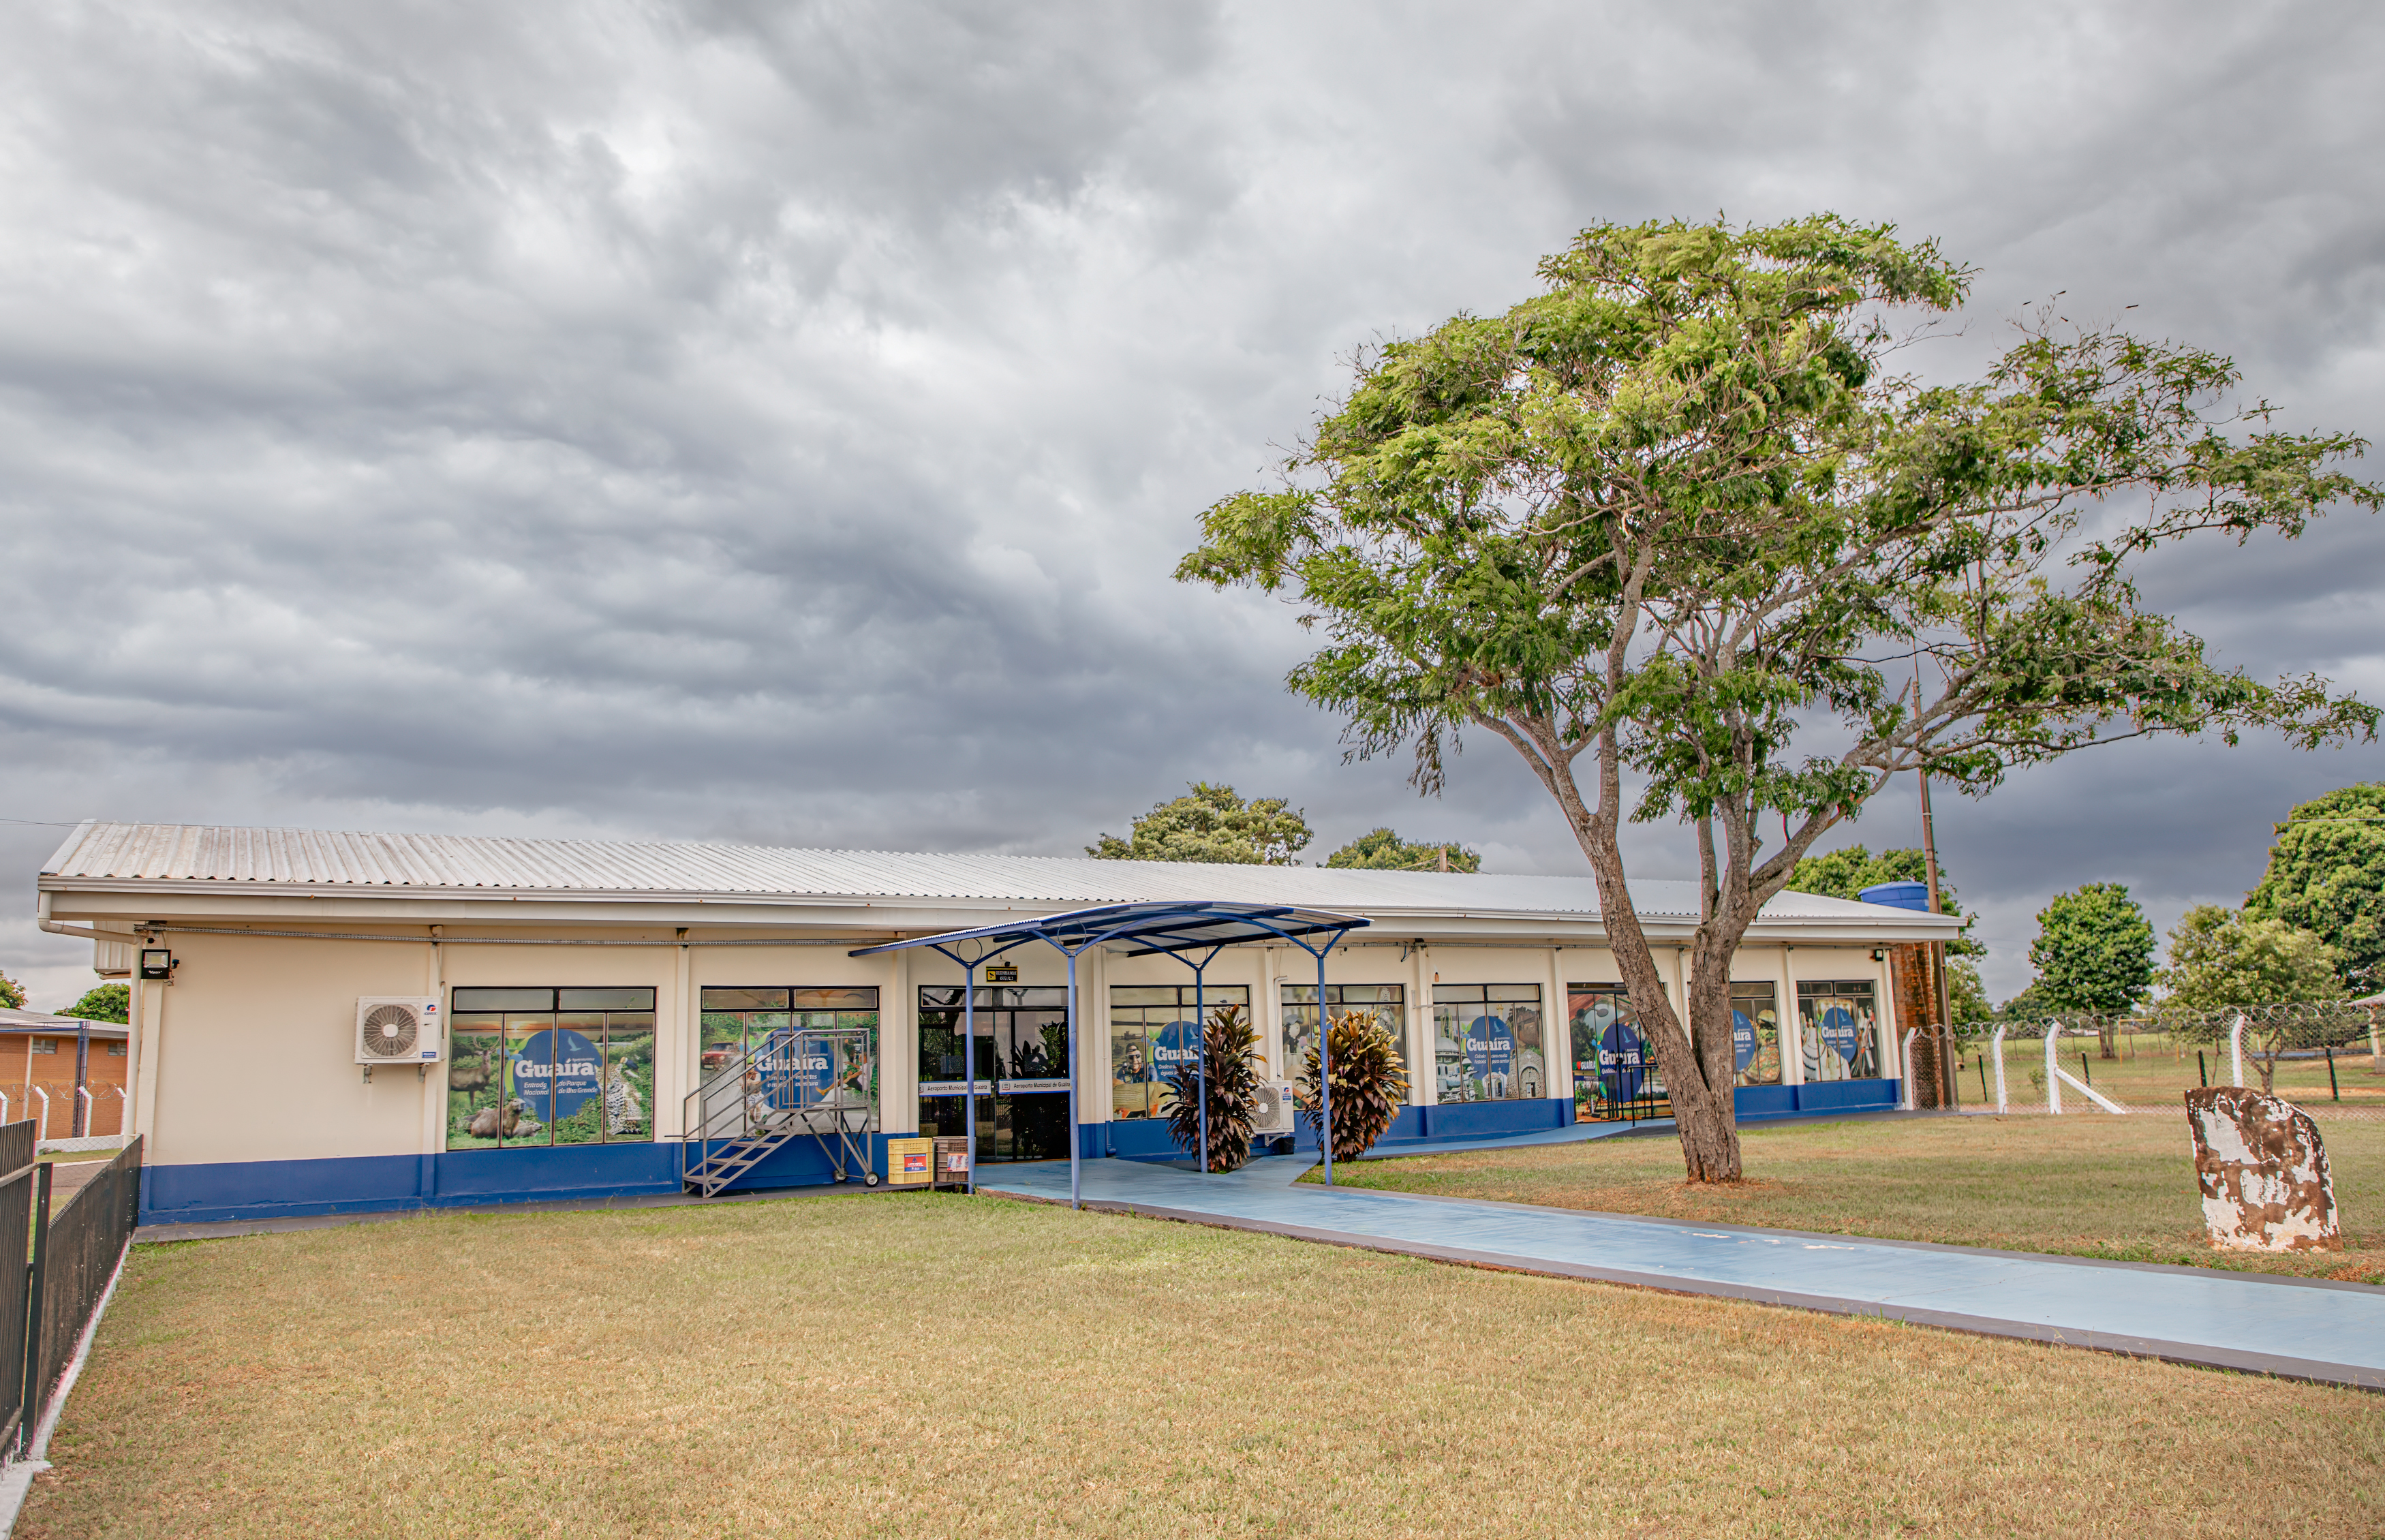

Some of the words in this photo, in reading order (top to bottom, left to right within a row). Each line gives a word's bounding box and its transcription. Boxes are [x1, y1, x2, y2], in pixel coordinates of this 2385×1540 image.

[1466, 1036, 1511, 1051] Guaíra
[1154, 1045, 1199, 1061] Guaí
[516, 1058, 595, 1078] Guaíra
[756, 1053, 829, 1072] Guaíra
